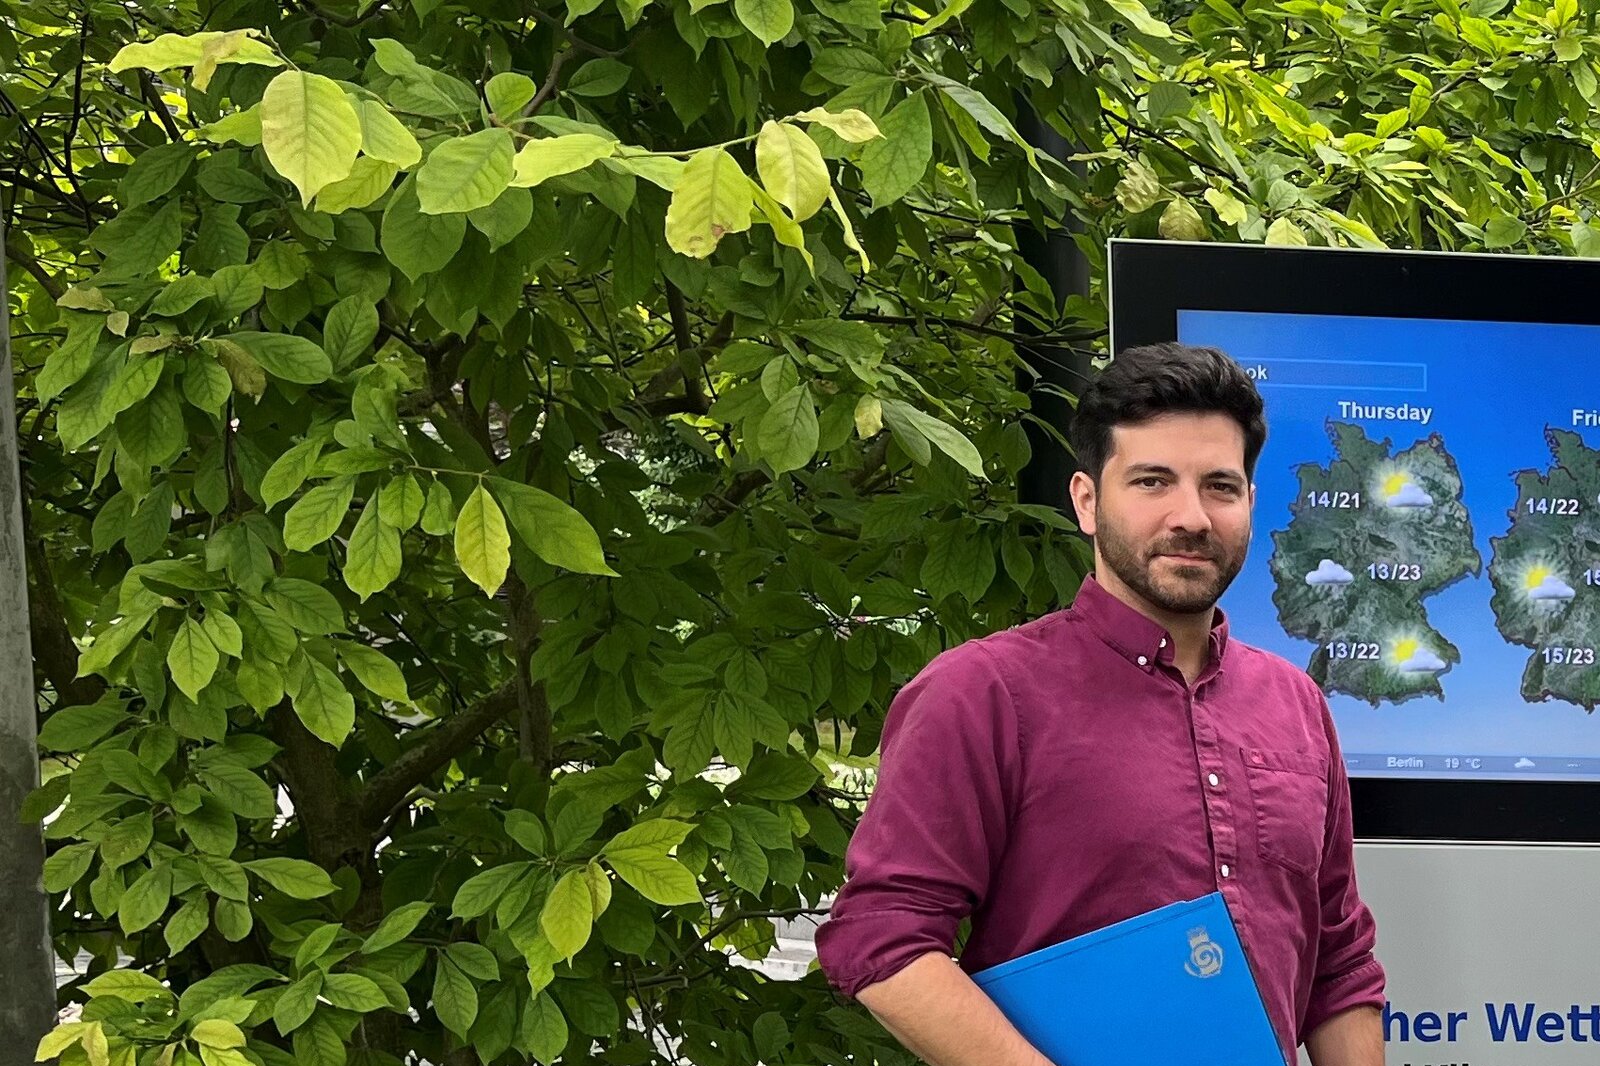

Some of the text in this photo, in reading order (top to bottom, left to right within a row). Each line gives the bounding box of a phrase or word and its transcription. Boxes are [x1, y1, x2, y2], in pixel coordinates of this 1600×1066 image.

[1338, 401, 1432, 425] Thursday
[1307, 491, 1361, 509] 14/21
[1526, 498, 1580, 515] 14/22
[1367, 563, 1421, 581] 13/23
[1325, 642, 1380, 660] 13/22
[1542, 647, 1595, 665] 15/23
[1387, 756, 1482, 769] Berlin 19 °C
